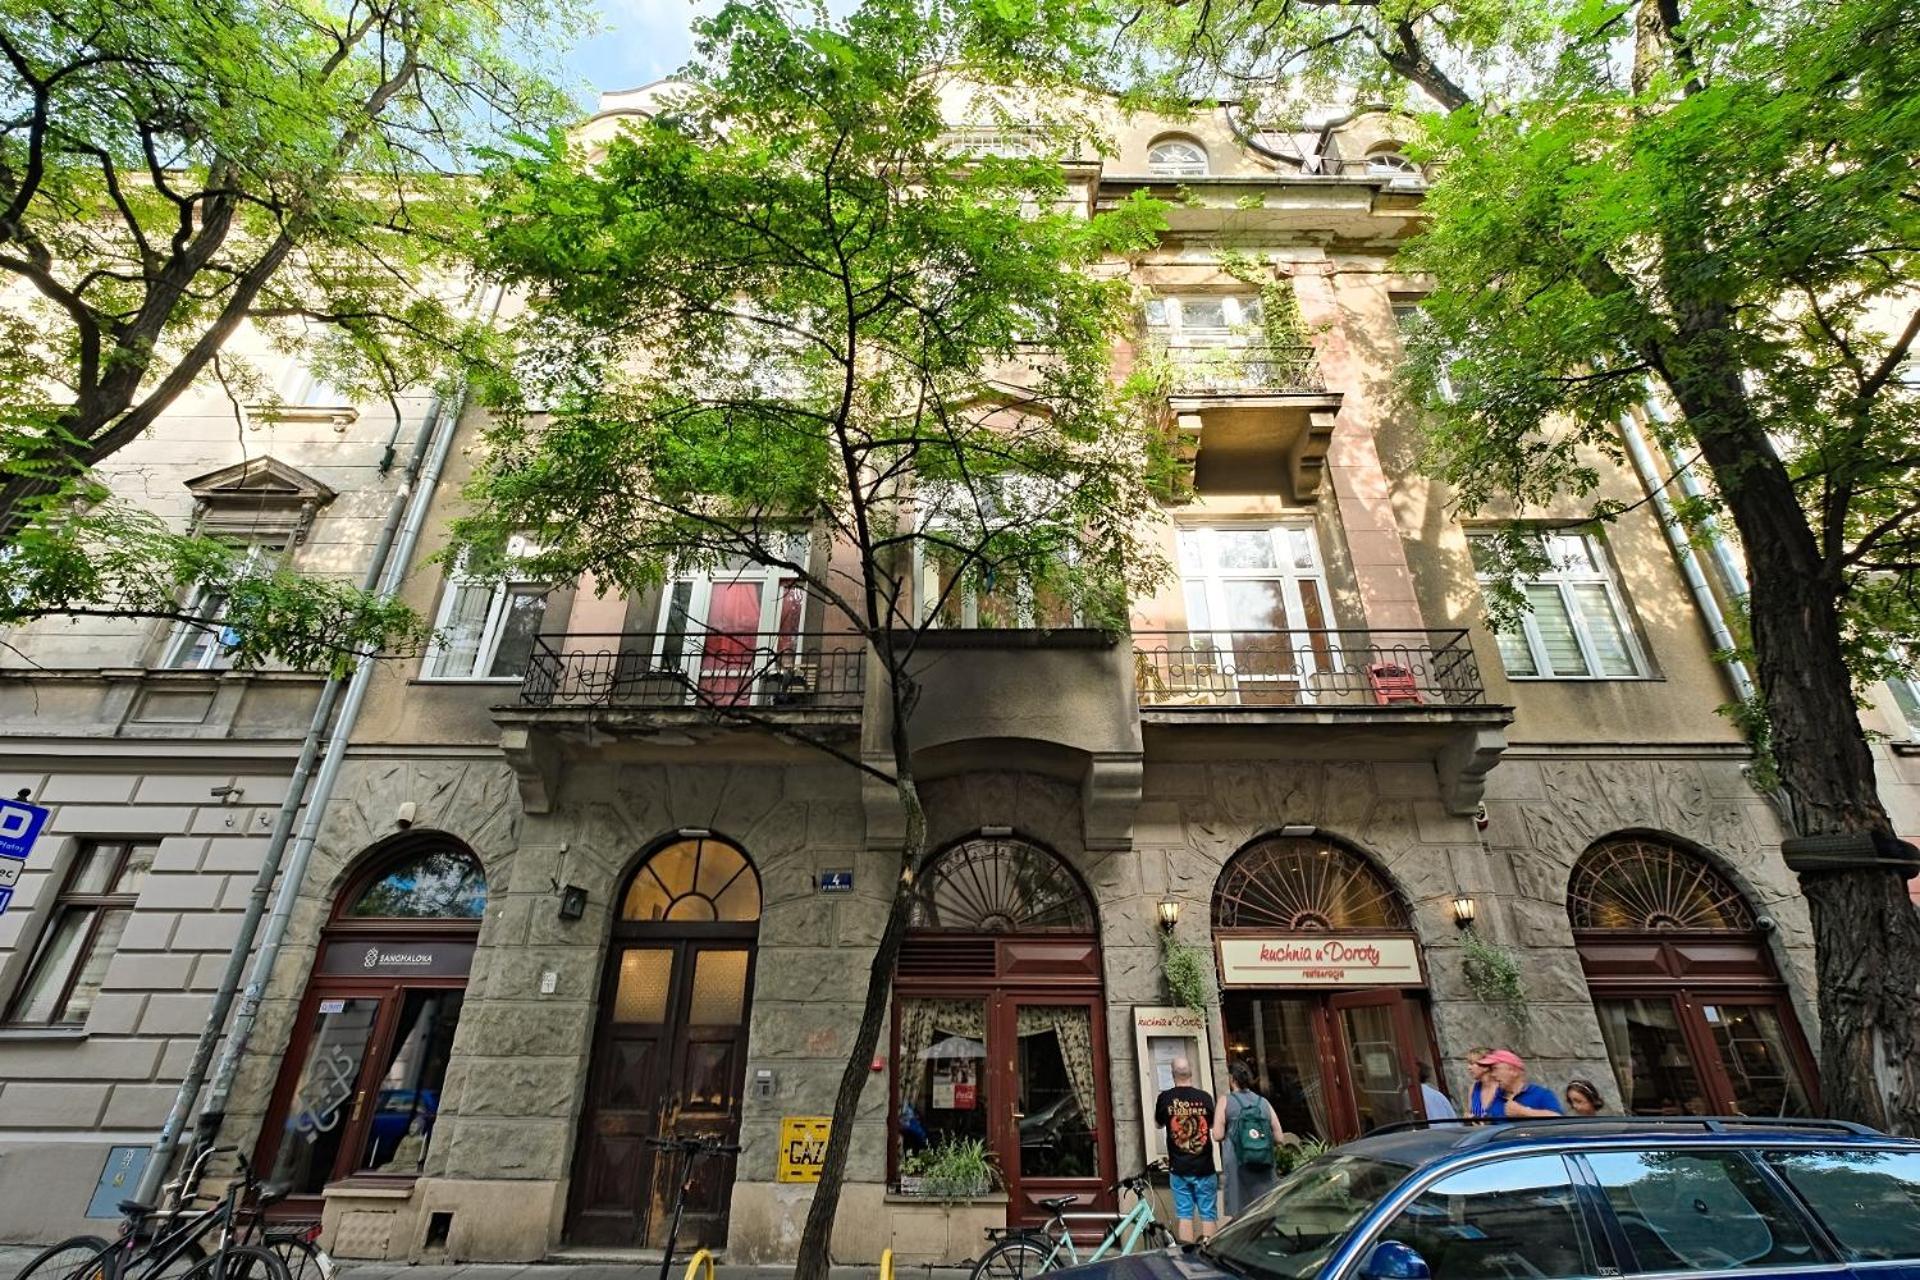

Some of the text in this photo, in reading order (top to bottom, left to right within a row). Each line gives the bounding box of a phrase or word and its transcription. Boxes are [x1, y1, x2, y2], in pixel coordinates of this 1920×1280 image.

[832, 873, 840, 886] 4
[1260, 941, 1380, 966] kuchnia u Doroty
[790, 1140, 825, 1165] GAZ
